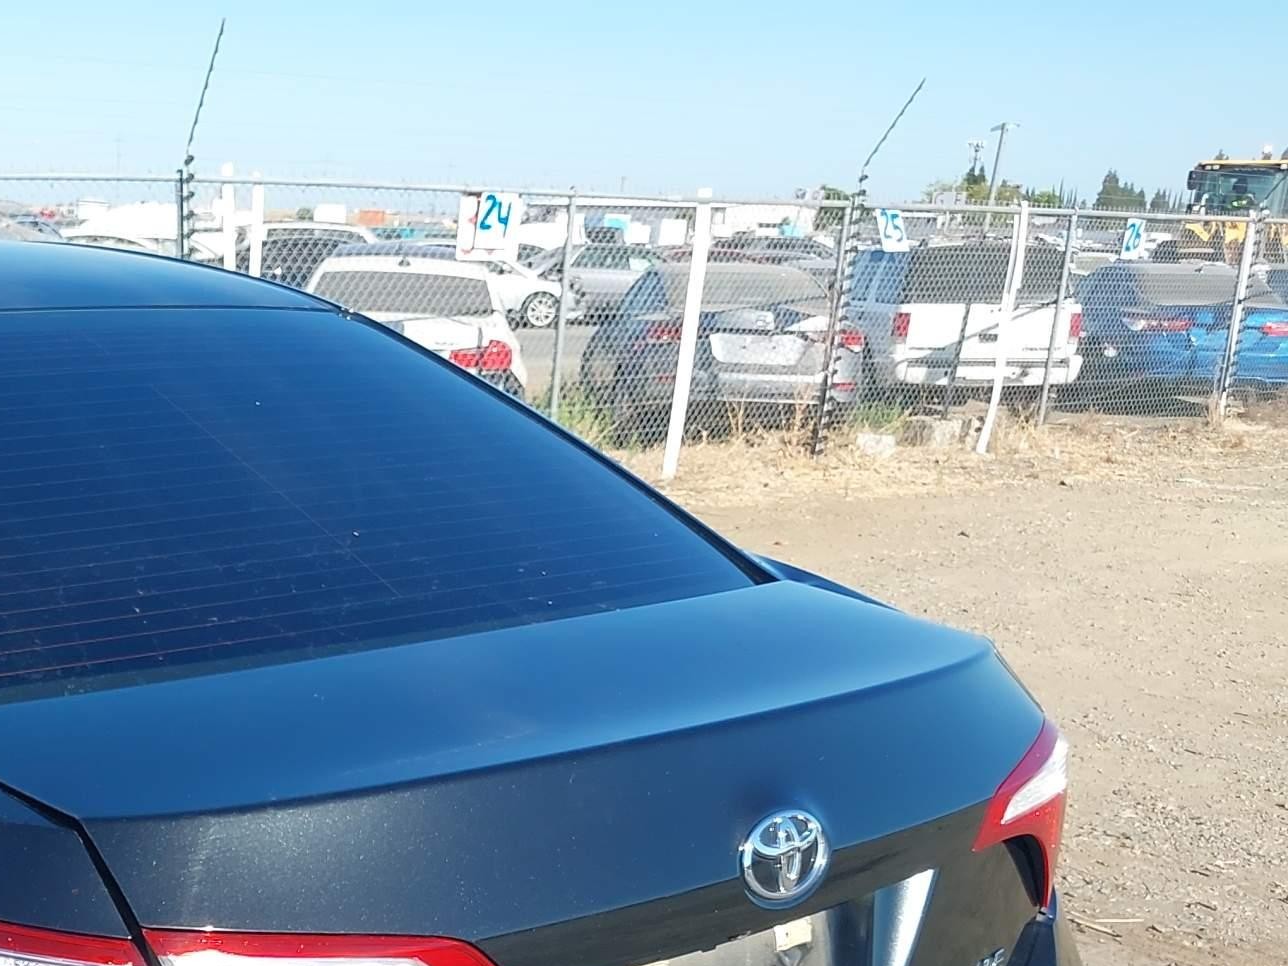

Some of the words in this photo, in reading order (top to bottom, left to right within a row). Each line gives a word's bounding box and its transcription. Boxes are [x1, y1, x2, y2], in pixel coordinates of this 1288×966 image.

[479, 194, 512, 238] 24
[880, 208, 904, 243] 25
[1125, 222, 1143, 252] 26
